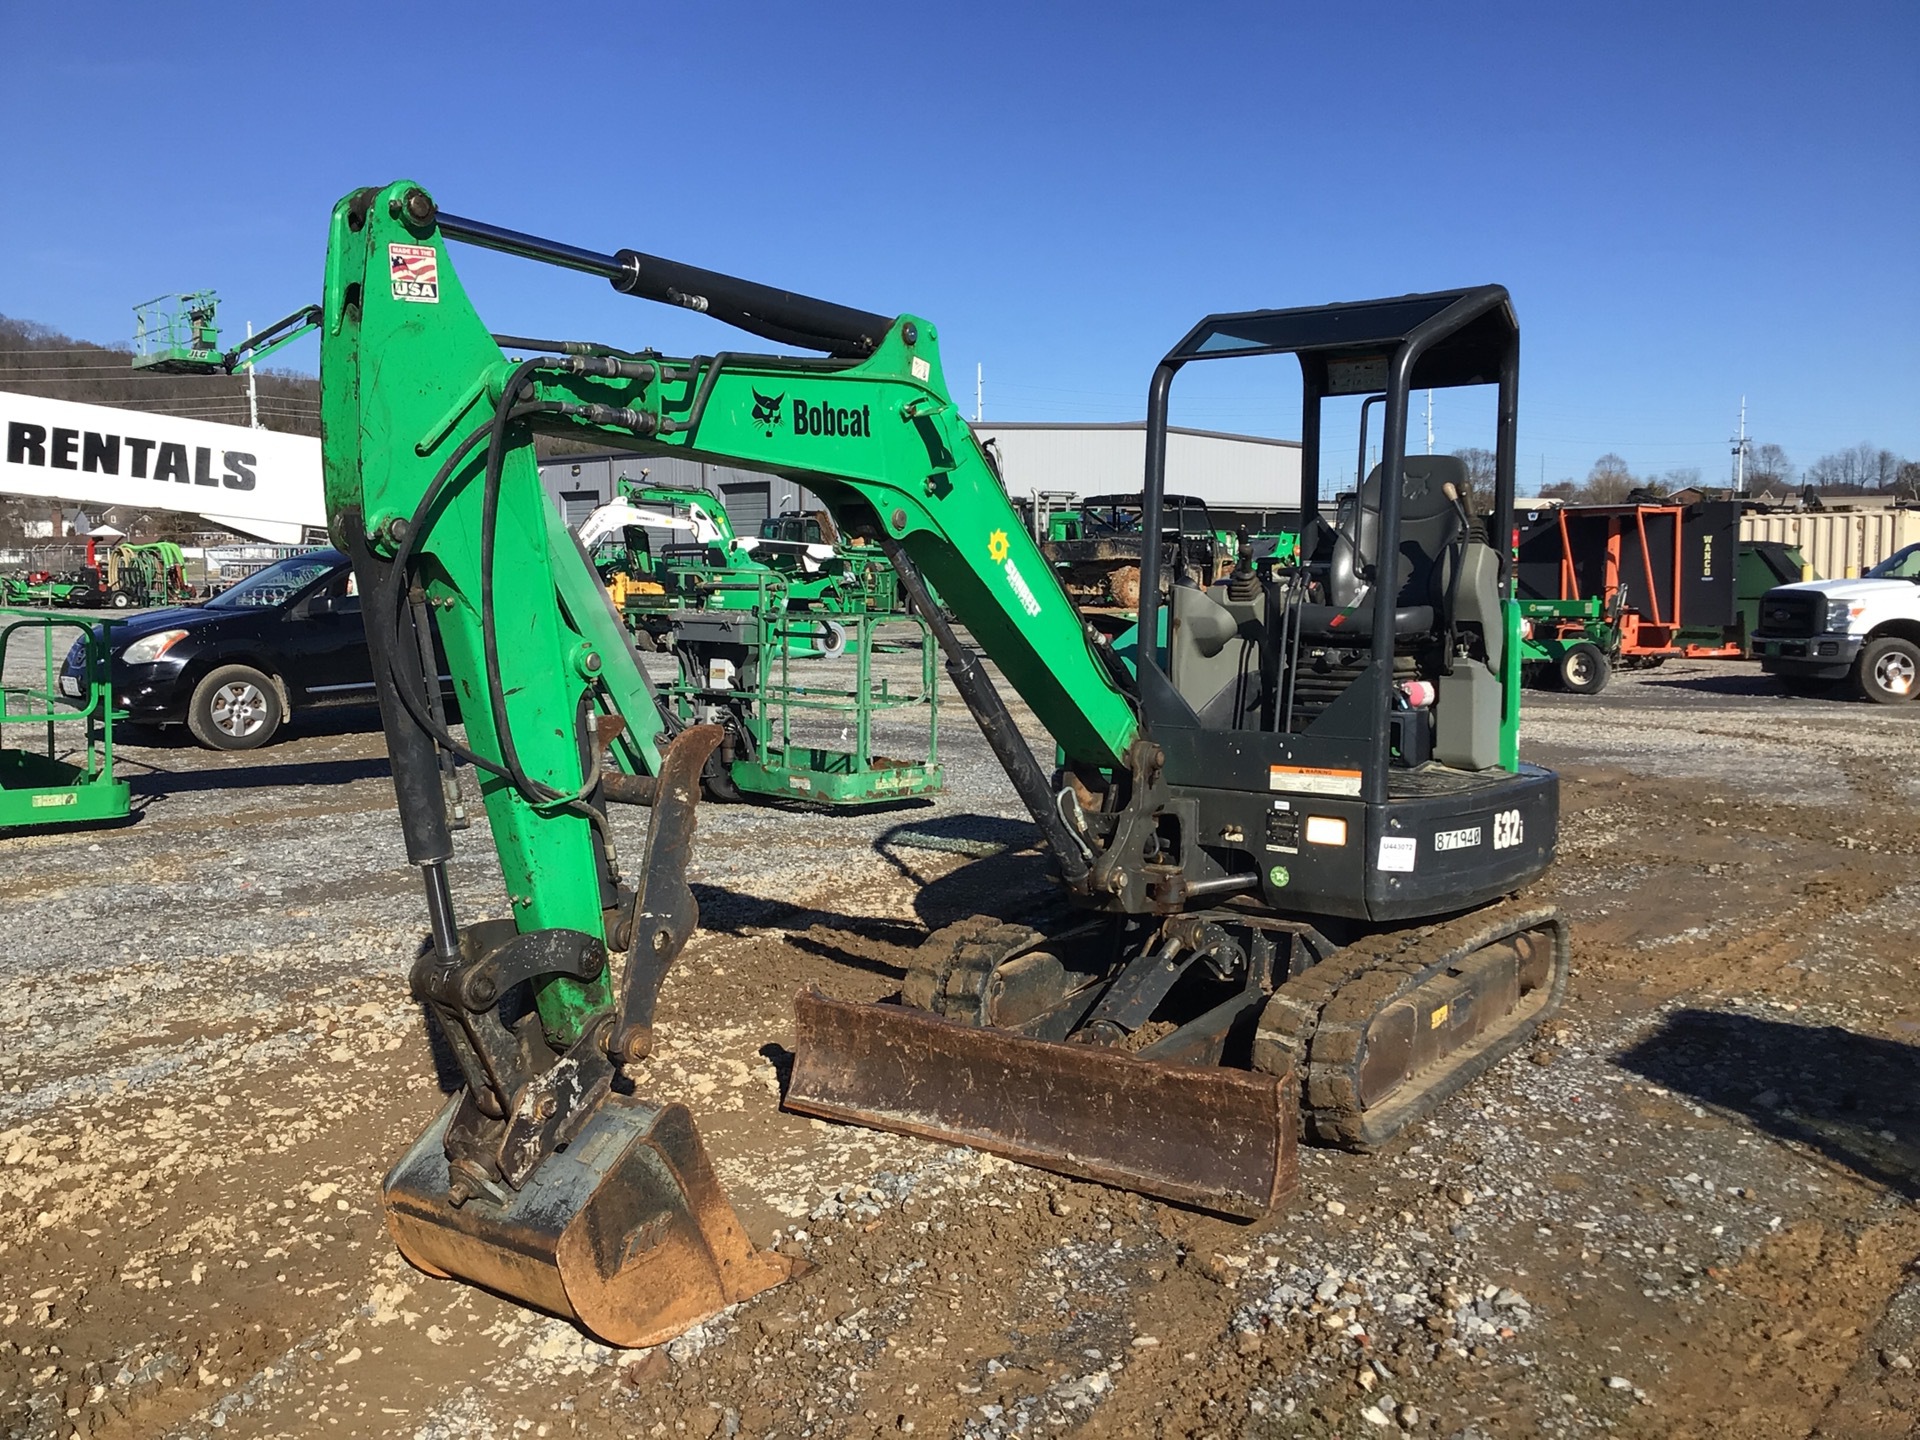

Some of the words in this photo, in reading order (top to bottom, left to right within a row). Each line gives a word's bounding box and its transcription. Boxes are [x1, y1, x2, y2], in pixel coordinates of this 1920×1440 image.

[392, 246, 411, 255] MADE
[394, 282, 435, 297] USA
[188, 349, 207, 359] JLG
[793, 398, 871, 438] Bobcat
[6, 421, 257, 491] RENTALS
[1702, 535, 1714, 576] WANCO
[1305, 768, 1332, 776] WARNING
[1437, 830, 1480, 850] 871940
